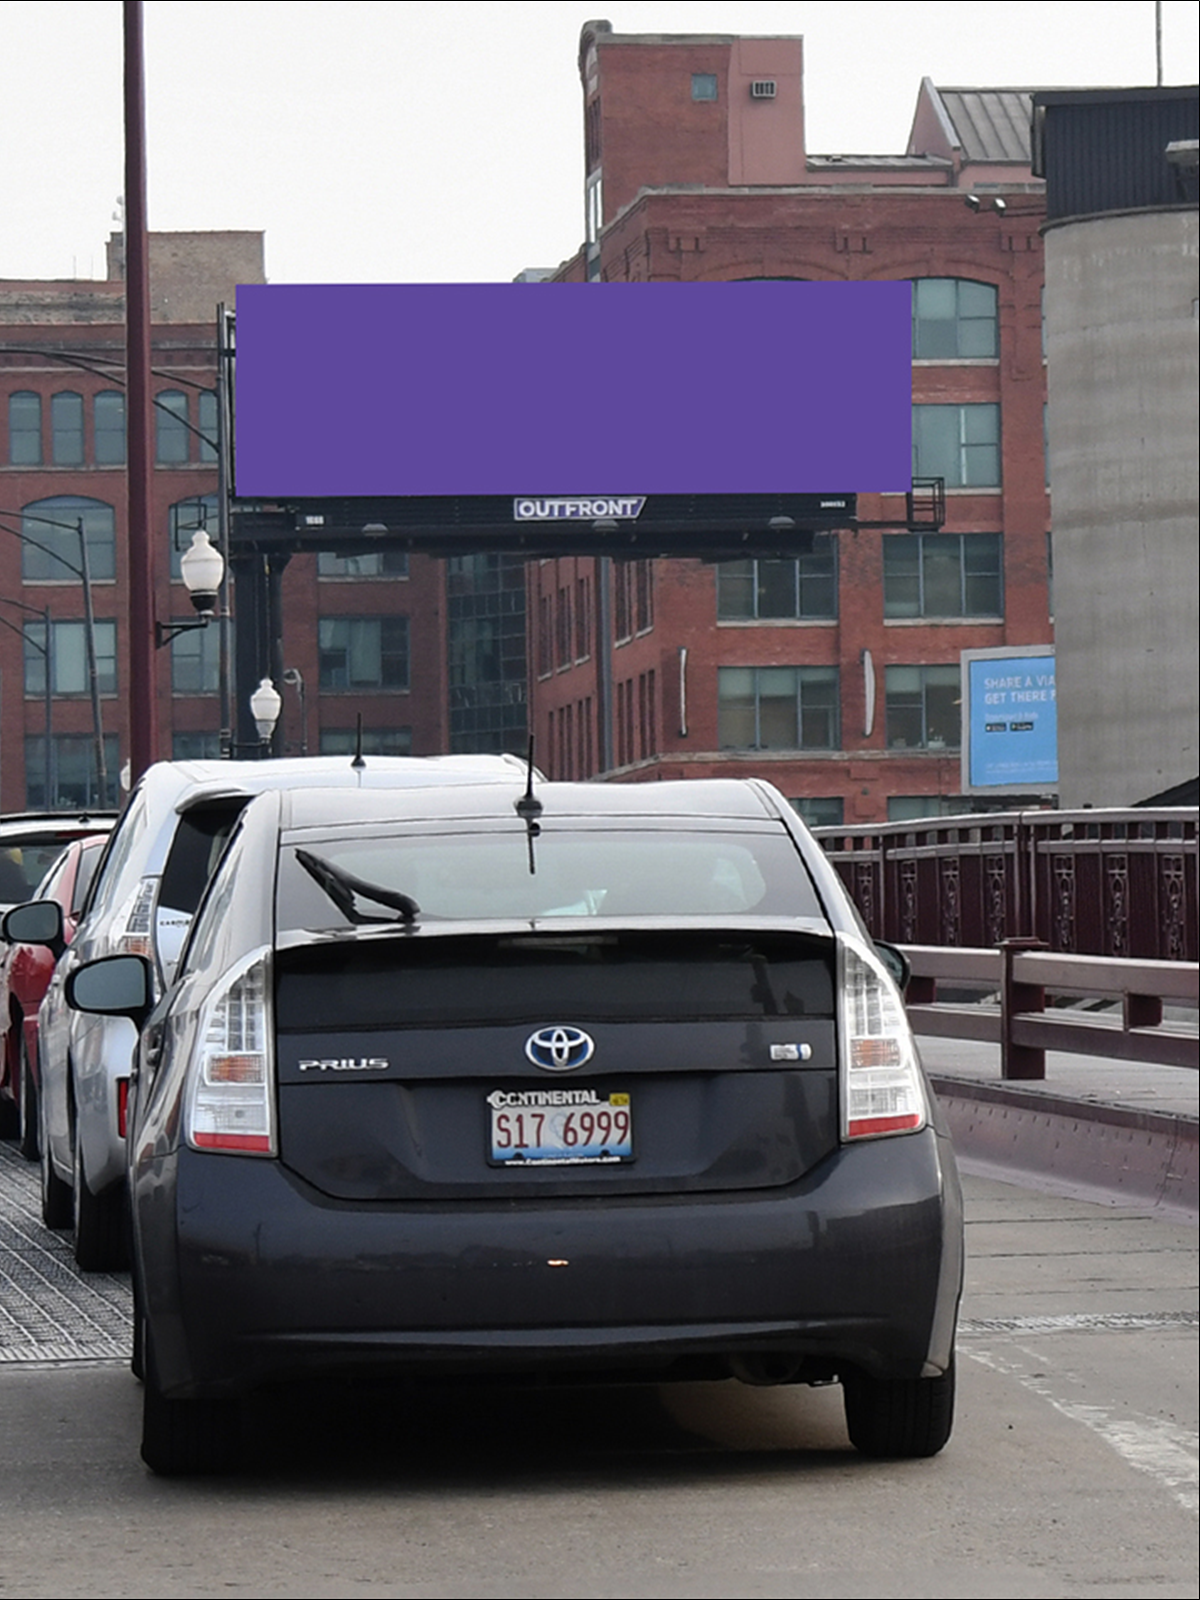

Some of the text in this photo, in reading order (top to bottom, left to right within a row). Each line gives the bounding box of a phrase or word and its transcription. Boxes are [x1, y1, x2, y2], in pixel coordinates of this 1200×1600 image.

[519, 499, 638, 517] OUTFRONT
[984, 676, 1022, 689] SHARE
[1024, 676, 1033, 688] A
[984, 692, 1007, 705] GET
[1010, 690, 1048, 703] THERE
[298, 1058, 389, 1071] PRIUS
[496, 1110, 630, 1149] S17 6999
